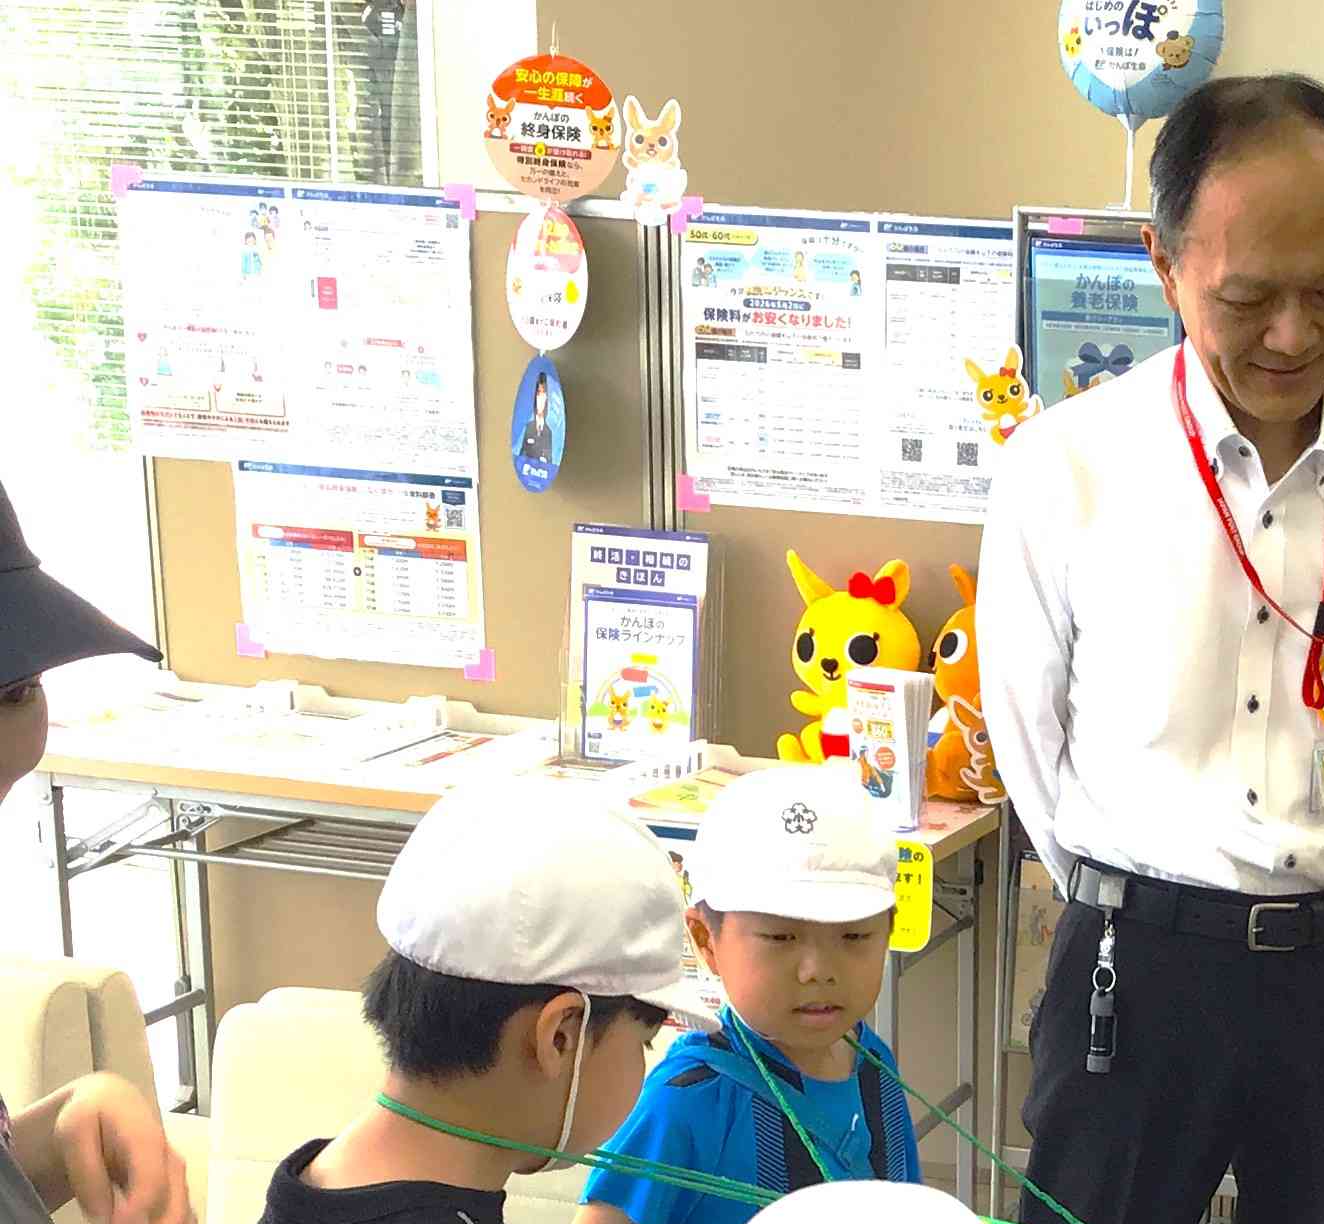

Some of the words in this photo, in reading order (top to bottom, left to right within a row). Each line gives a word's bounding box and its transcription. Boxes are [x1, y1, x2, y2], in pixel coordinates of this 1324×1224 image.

[515, 68, 593, 88] 安心の保障が
[523, 86, 584, 104] 一生涯続く
[534, 112, 570, 123] かんぽの
[520, 122, 582, 142] 終身保険
[1074, 273, 1136, 291] かんぽの
[1070, 291, 1139, 313] 養老保険
